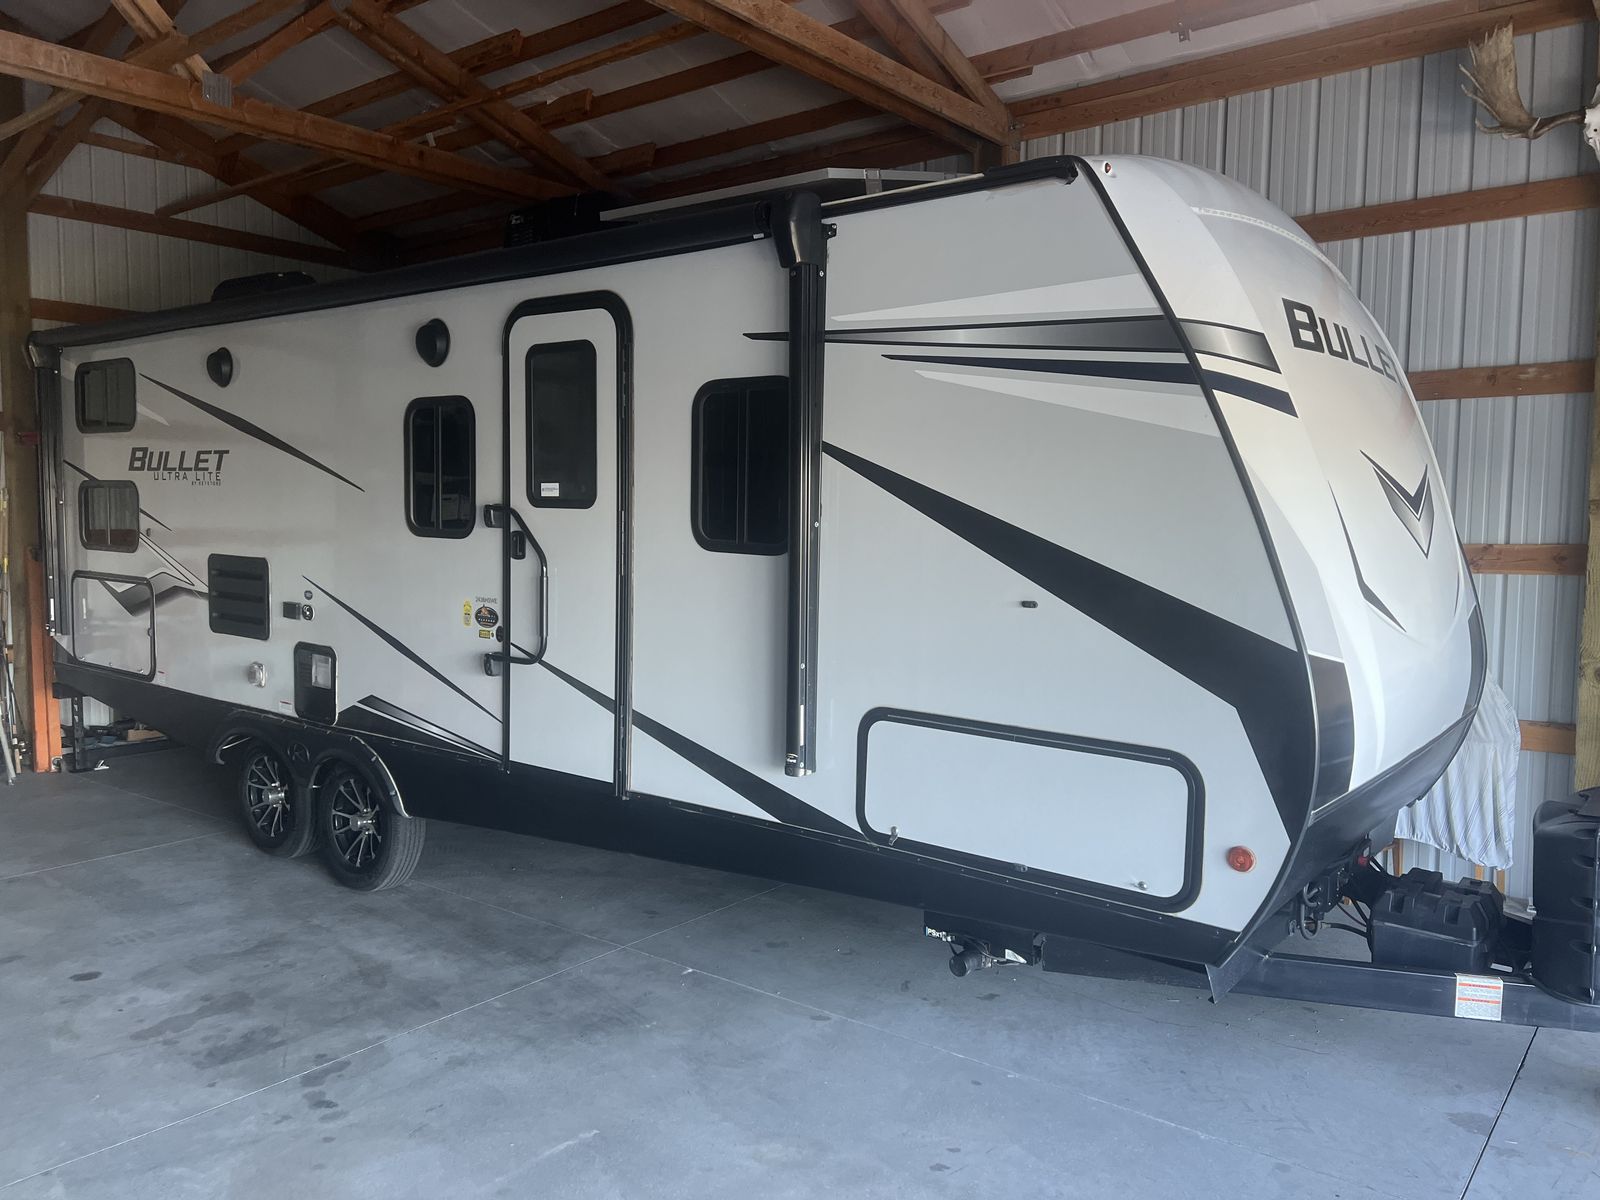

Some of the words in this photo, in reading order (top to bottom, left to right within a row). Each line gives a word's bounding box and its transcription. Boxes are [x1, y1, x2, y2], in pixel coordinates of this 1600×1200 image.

[128, 446, 230, 472] BULLET
[153, 471, 189, 481] ULTRA
[195, 471, 221, 481] LITE
